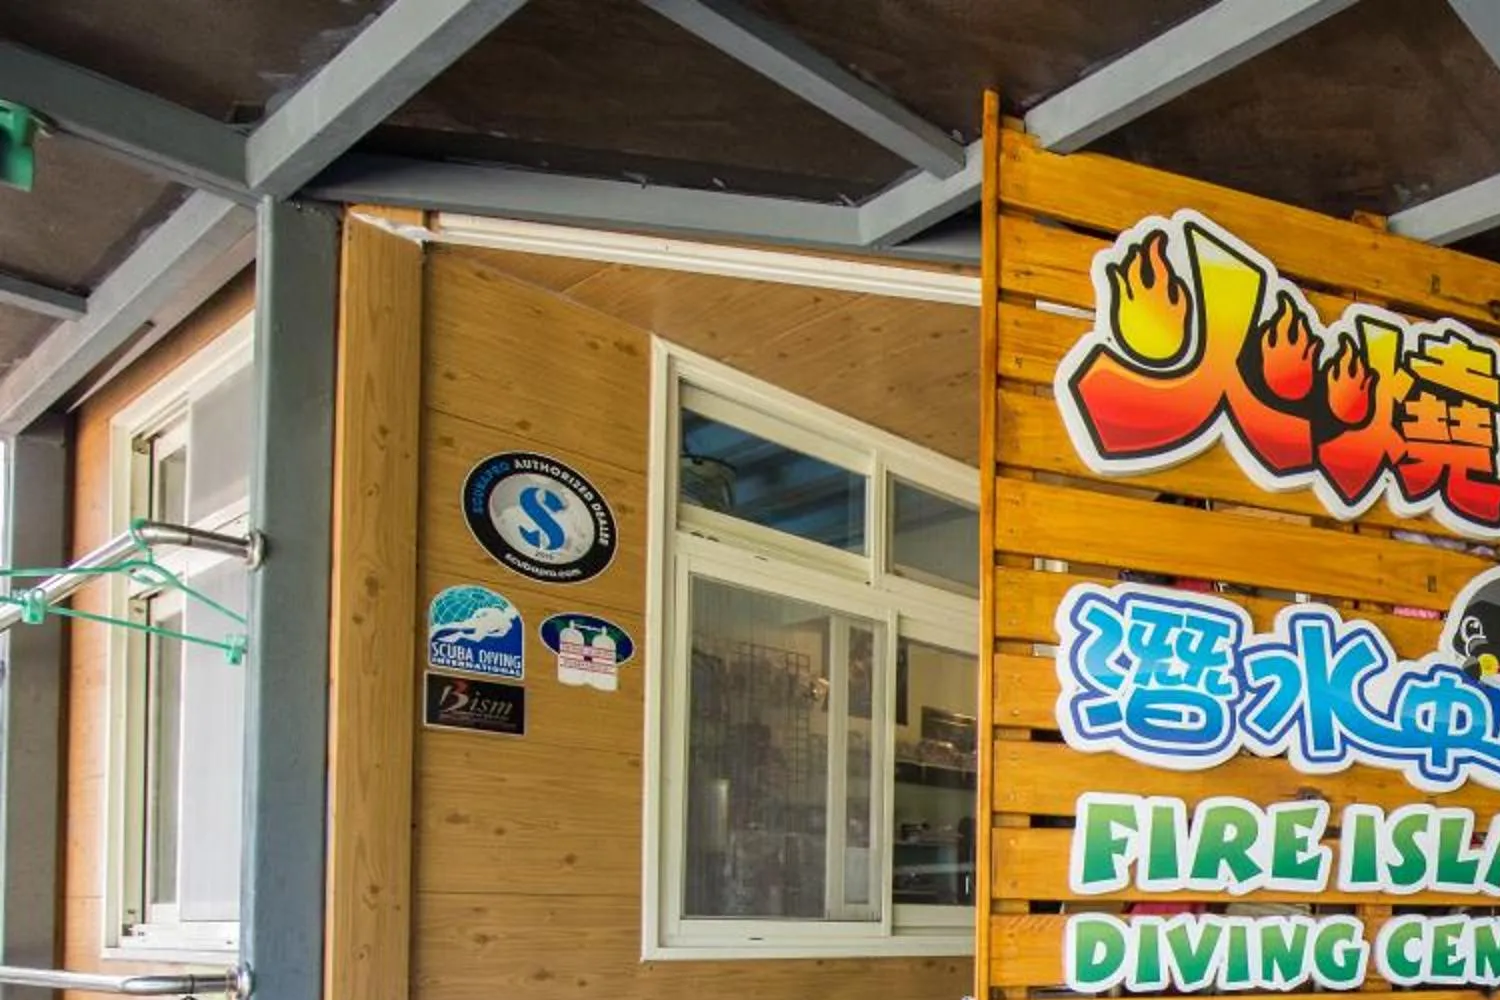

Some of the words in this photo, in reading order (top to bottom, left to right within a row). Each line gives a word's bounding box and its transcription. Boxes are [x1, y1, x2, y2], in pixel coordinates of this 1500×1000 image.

[514, 459, 594, 503] AUTHORIZED
[591, 503, 611, 547] DEALER
[431, 641, 473, 662] SCUBA
[479, 649, 521, 669] DIVING
[1080, 802, 1328, 890] FIRE
[1072, 918, 1363, 985] DIVING
